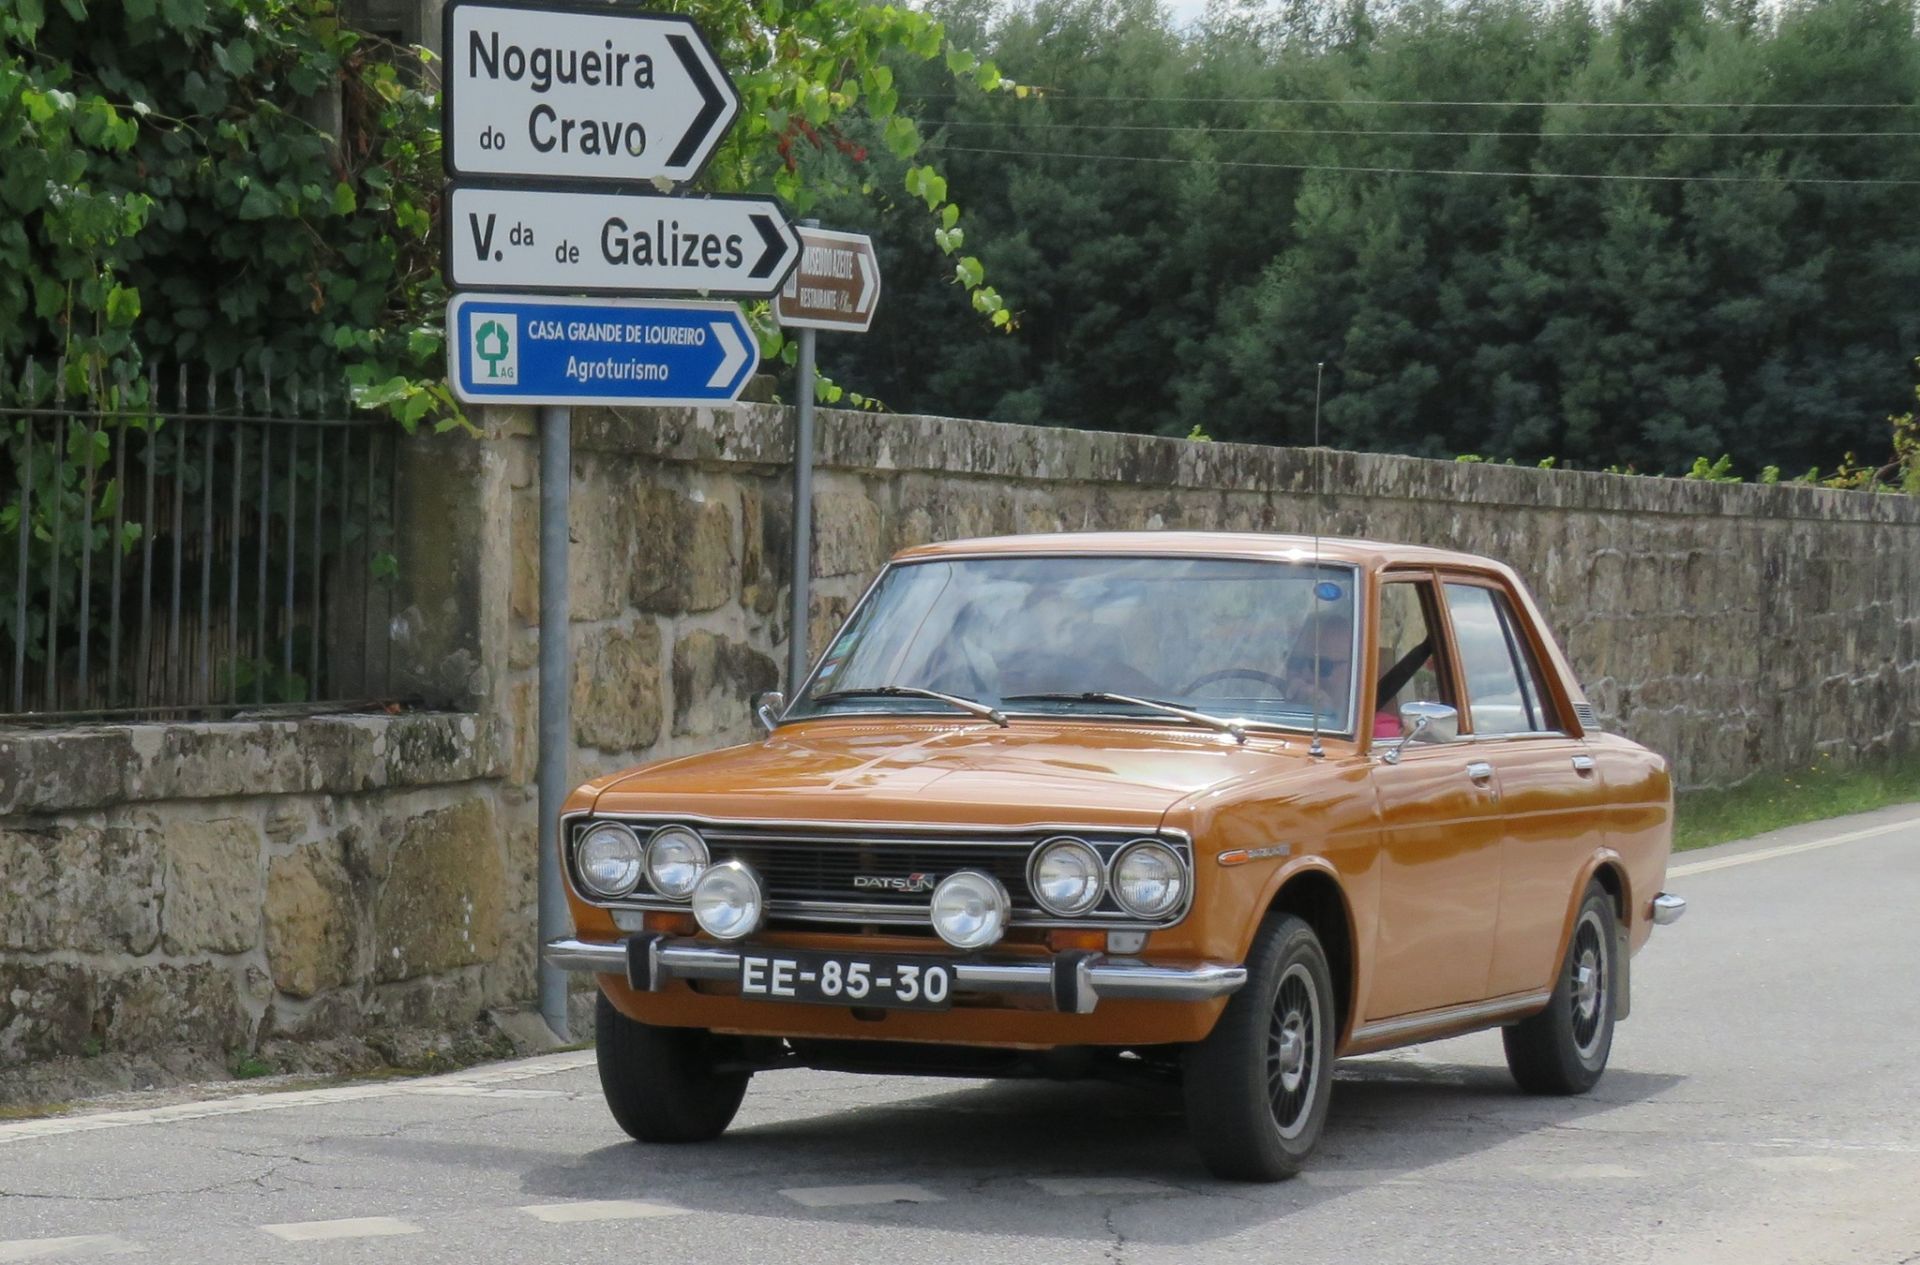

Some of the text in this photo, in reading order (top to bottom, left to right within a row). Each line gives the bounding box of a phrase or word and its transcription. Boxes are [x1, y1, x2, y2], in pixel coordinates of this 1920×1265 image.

[469, 30, 655, 93] Nogueira
[479, 103, 646, 157] do Cravo
[555, 240, 580, 264] de
[601, 217, 743, 269] Galizes
[528, 320, 706, 346] CASA GRANDE DE LOUREIRO
[500, 367, 514, 379] AG
[566, 355, 669, 383] Agroturismo
[854, 876, 935, 889] DATSUN
[742, 956, 949, 1003] EE-85-30
